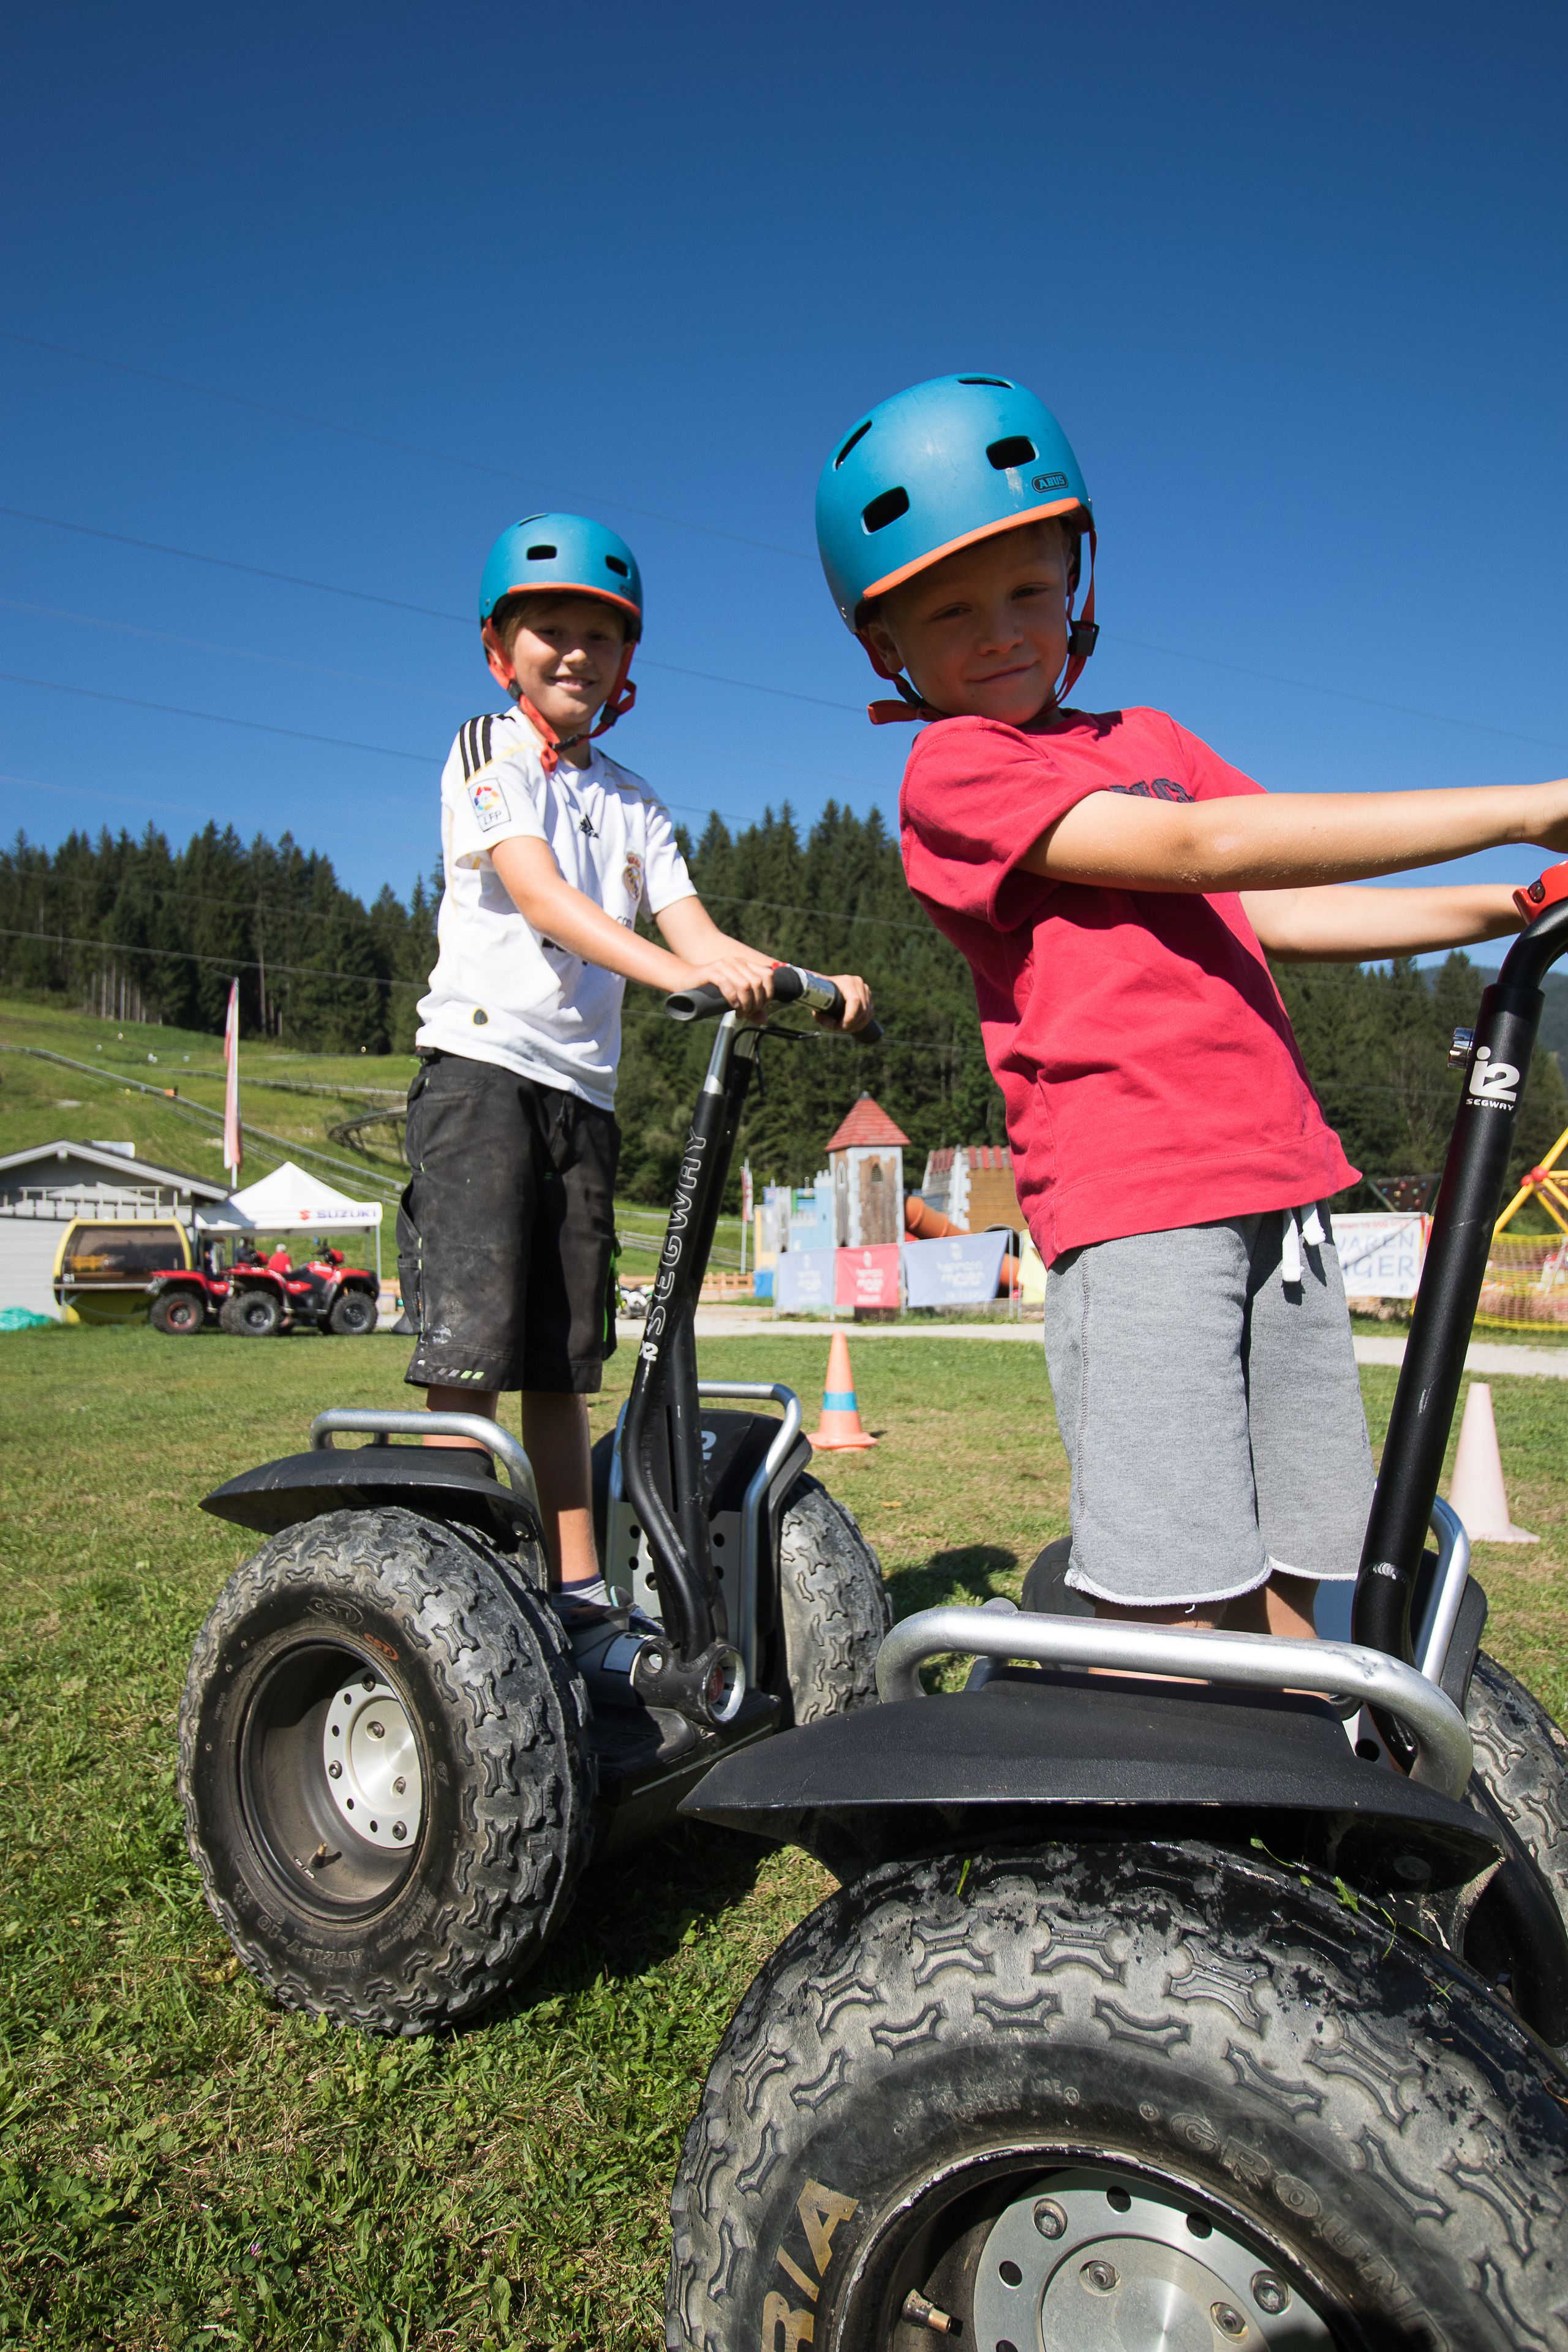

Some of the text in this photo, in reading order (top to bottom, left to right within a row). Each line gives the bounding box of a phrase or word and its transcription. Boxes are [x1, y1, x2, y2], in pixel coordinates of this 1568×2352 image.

[1038, 475, 1066, 489] ABUS
[484, 810, 502, 825] LFP
[1469, 1046, 1520, 1102] i2
[1465, 1098, 1514, 1111] SEGWAY
[317, 1210, 377, 1219] SUZUKI
[645, 1125, 707, 1336] SEGWAY
[308, 1597, 354, 1623] CST
[363, 1632, 398, 1661] CST
